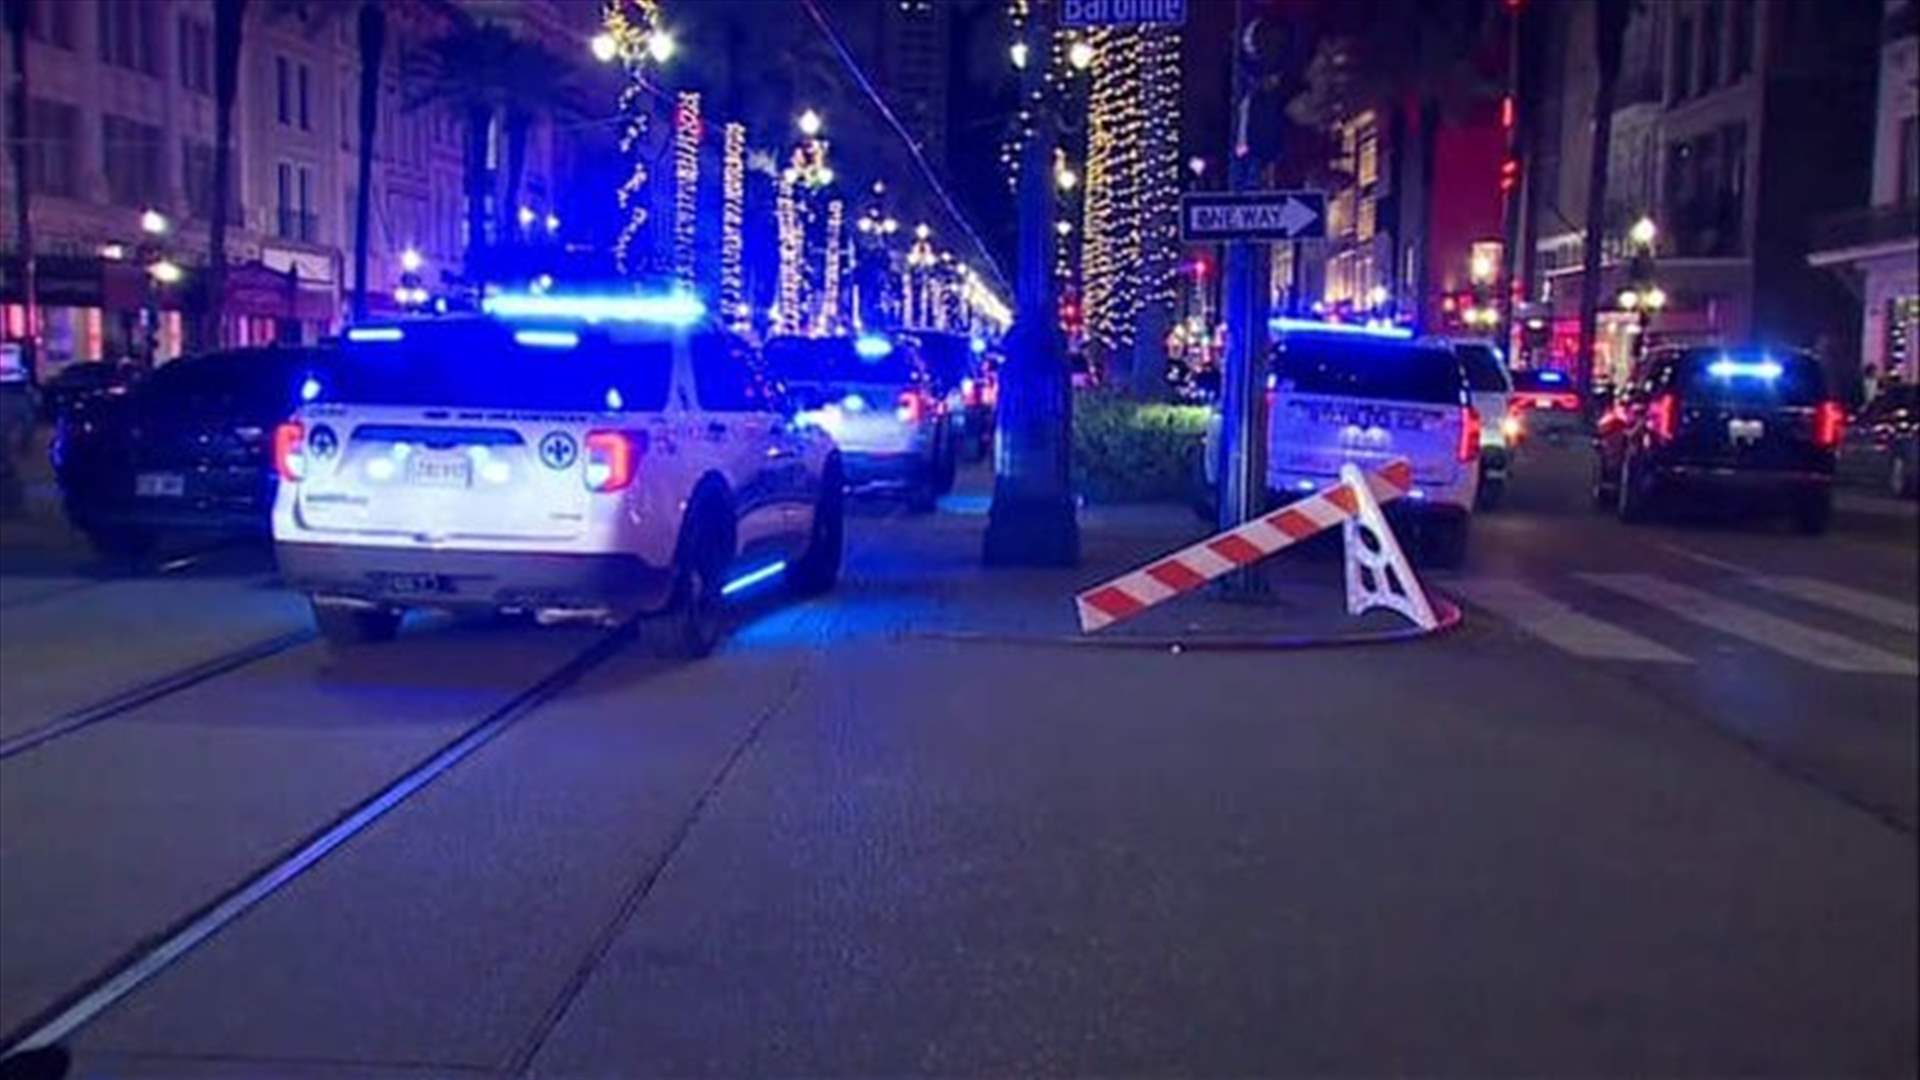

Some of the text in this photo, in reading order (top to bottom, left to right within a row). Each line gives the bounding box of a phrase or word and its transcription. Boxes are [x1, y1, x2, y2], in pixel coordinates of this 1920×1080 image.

[1064, 0, 1181, 21] Baronne
[1196, 207, 1286, 230] ONE WAY
